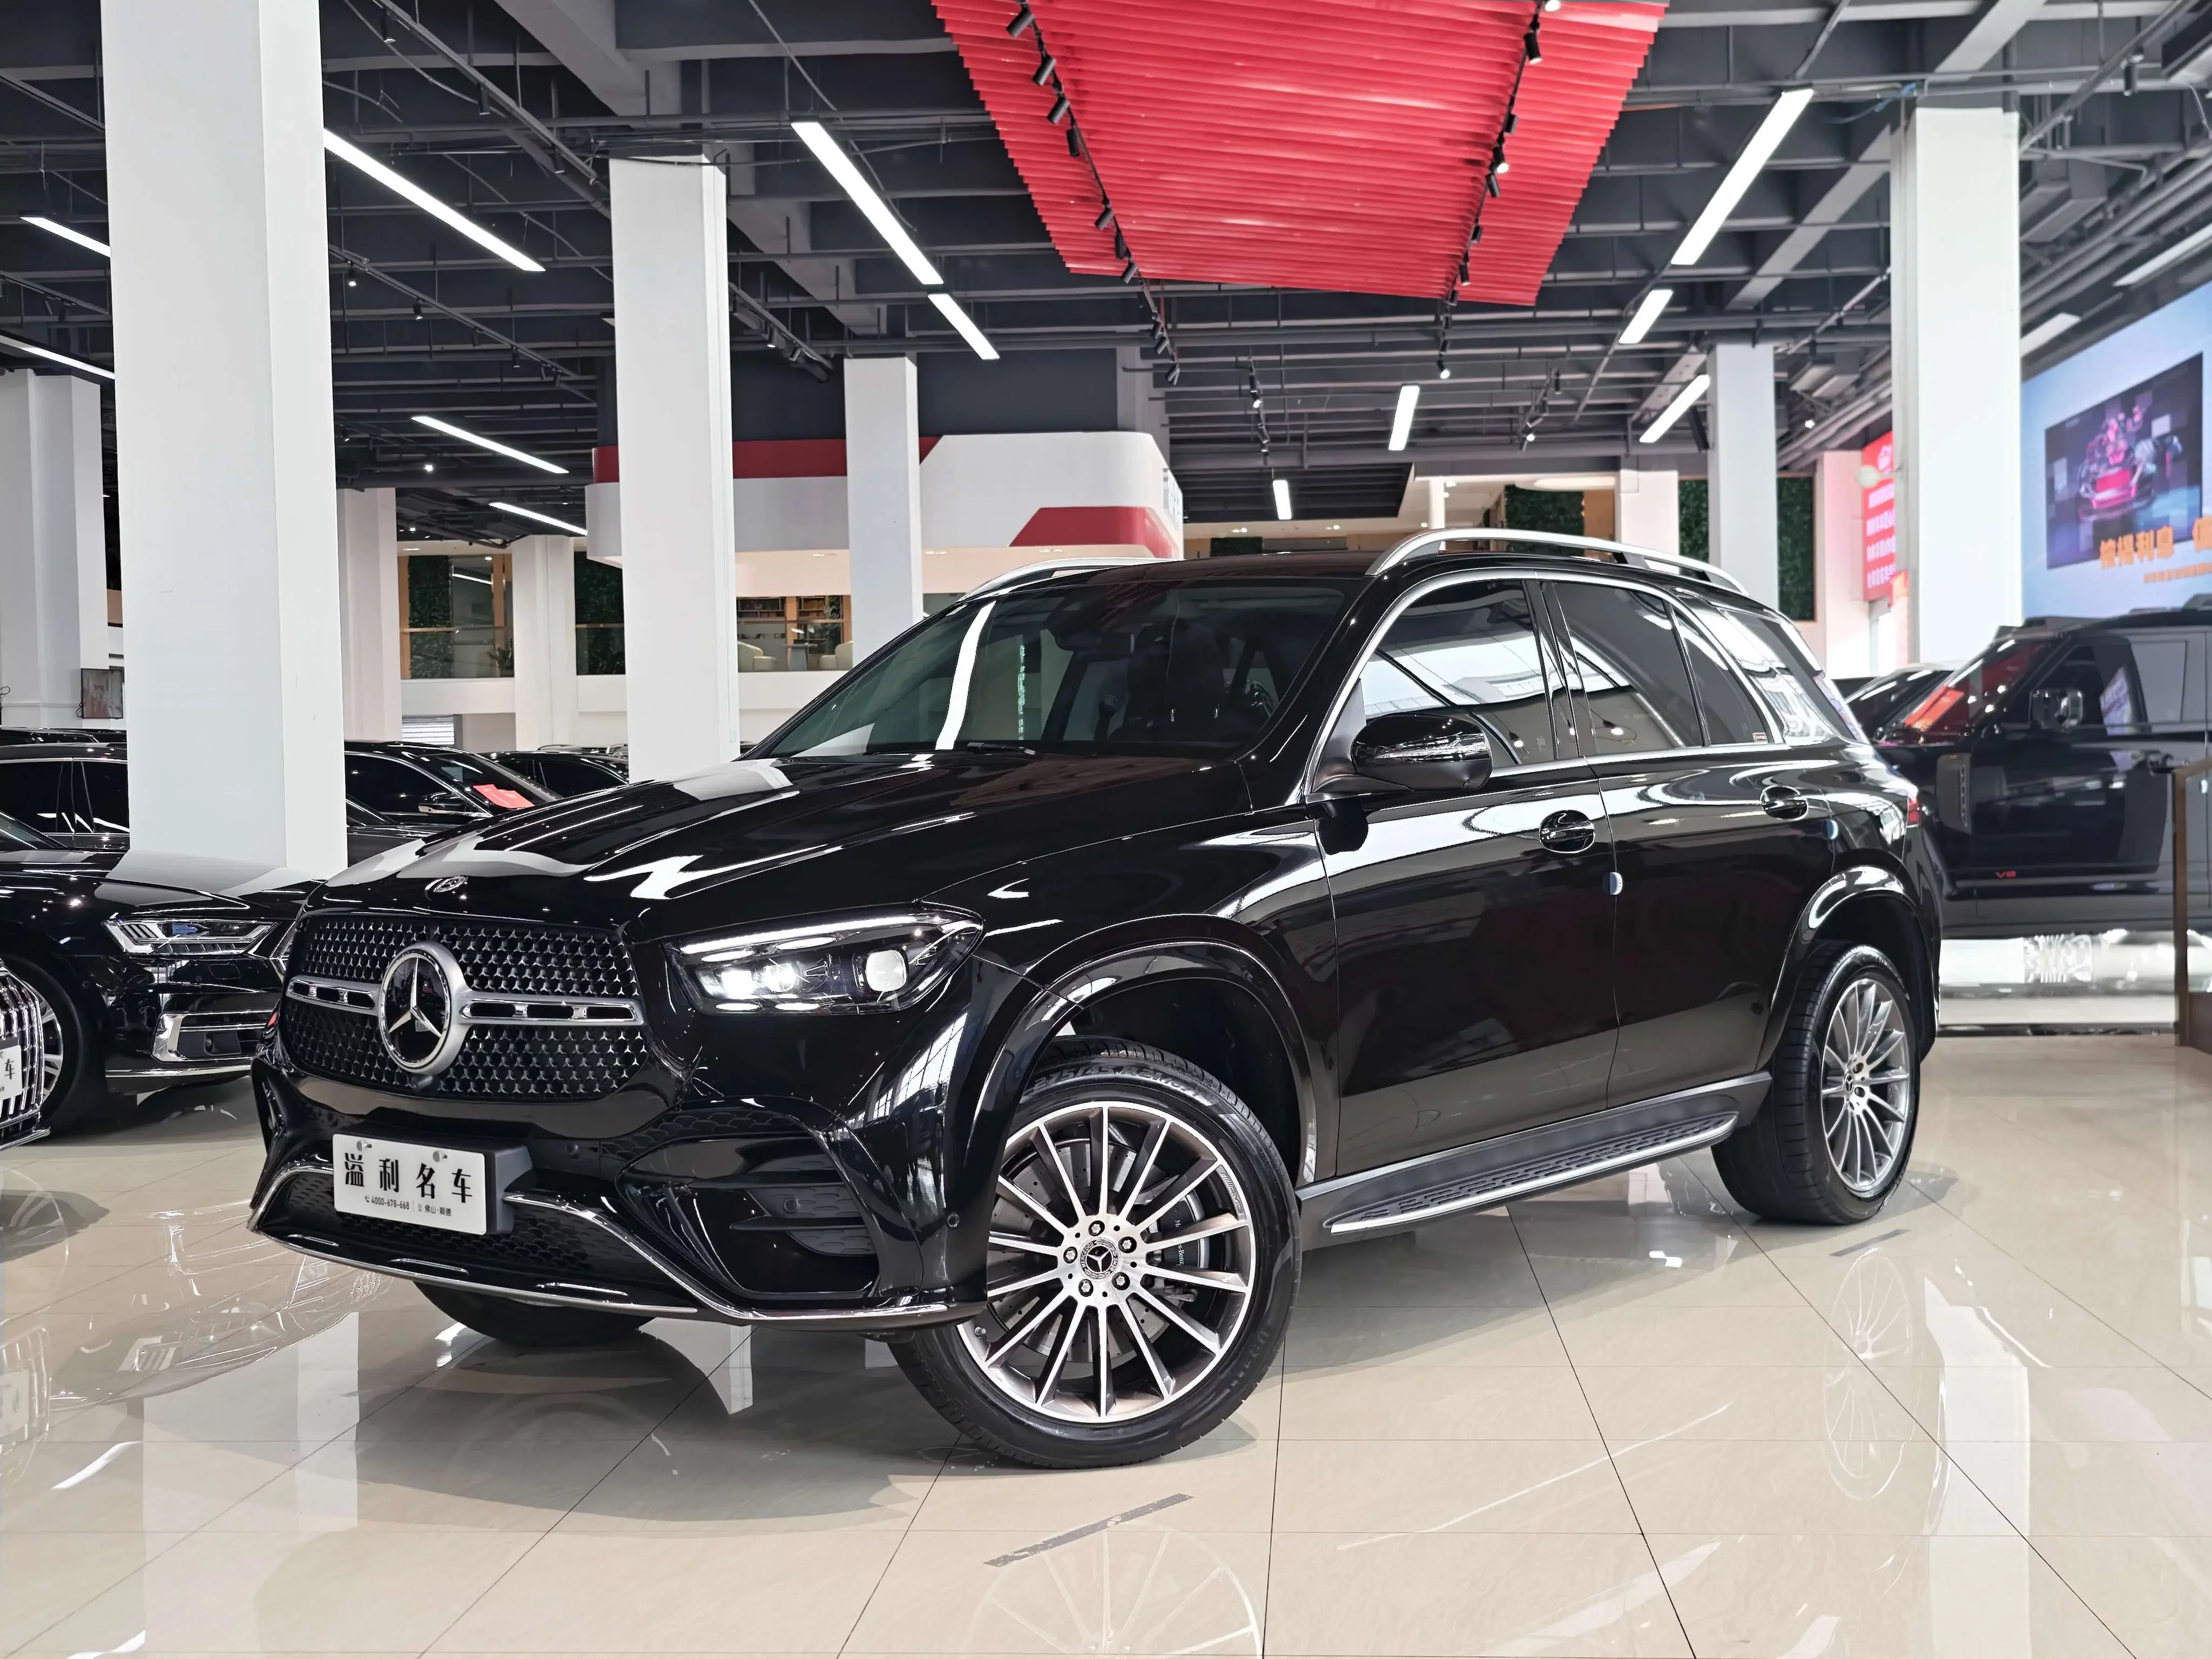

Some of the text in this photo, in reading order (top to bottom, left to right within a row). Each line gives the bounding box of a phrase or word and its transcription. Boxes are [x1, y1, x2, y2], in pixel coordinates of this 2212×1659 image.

[345, 1152, 473, 1203] 溢利名车
[371, 1196, 410, 1210] 4000-678-668
